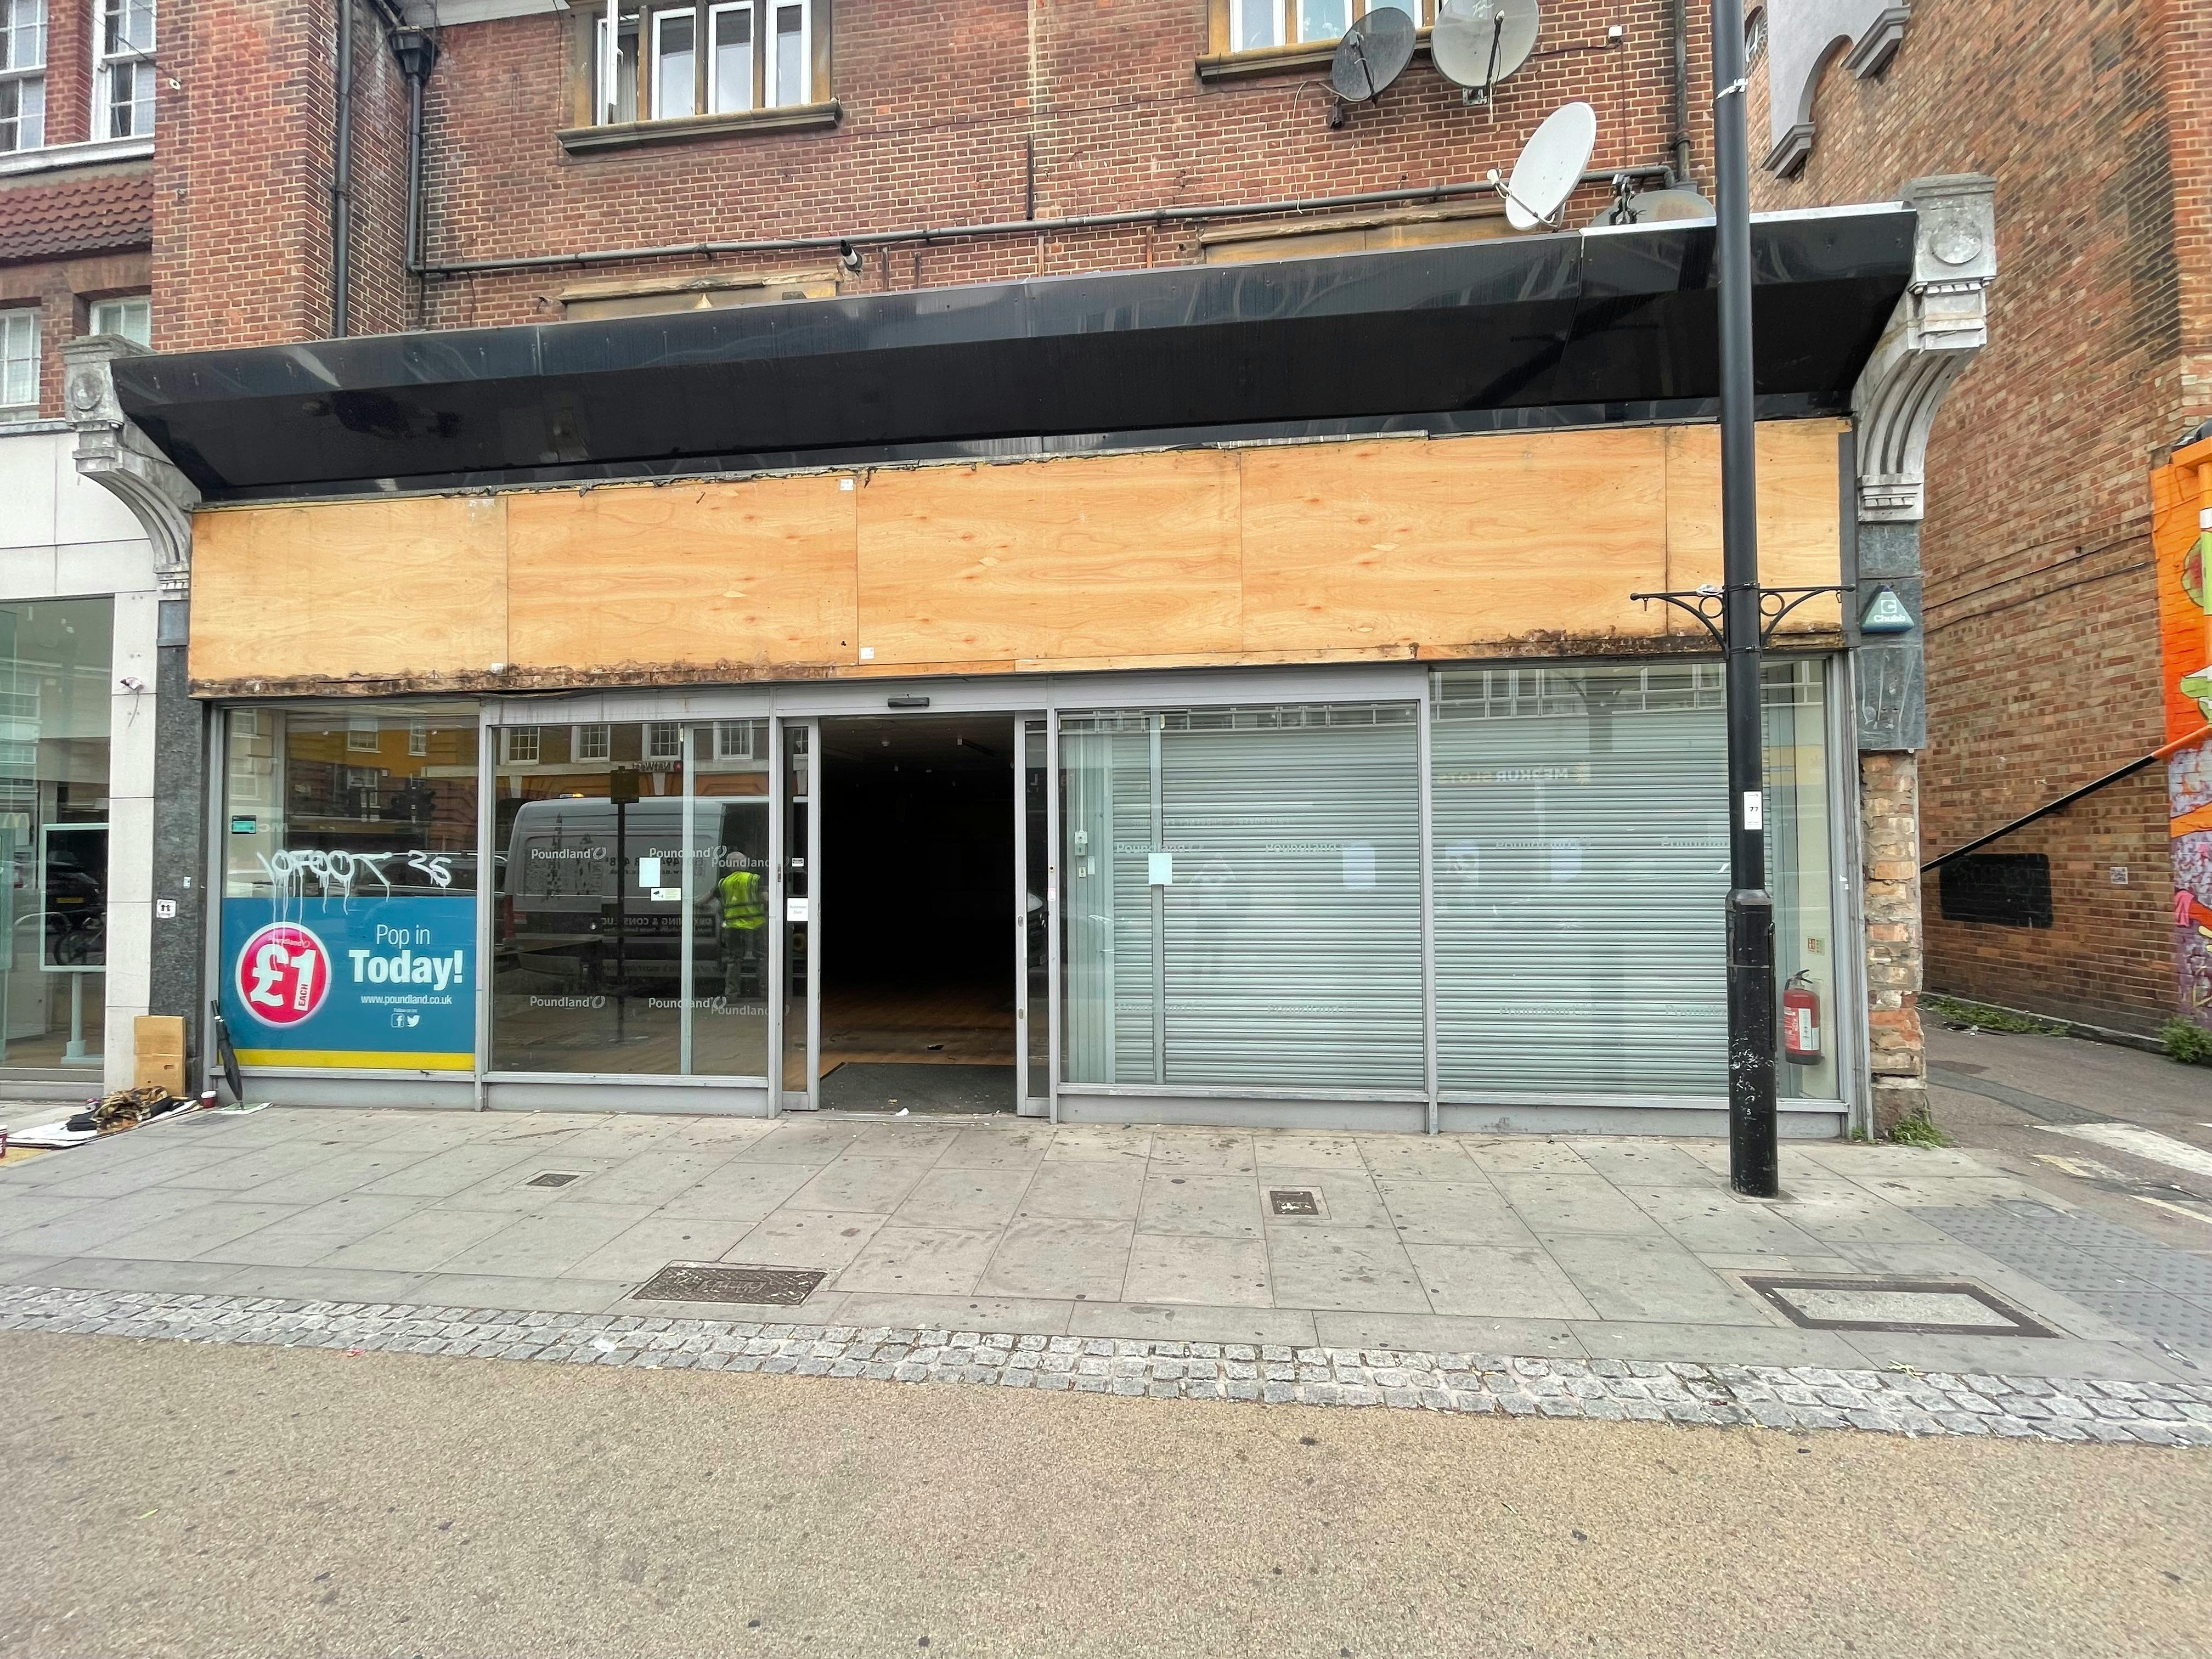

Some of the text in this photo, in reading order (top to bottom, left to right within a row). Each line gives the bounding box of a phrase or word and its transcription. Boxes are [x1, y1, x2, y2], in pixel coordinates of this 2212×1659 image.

[531, 848, 590, 860] Poundland
[376, 924, 431, 950] Pop in
[250, 943, 317, 1012] £1
[348, 949, 464, 991] Today!
[298, 984, 308, 1007] EACH
[360, 994, 453, 1006] www.poundland.co.uk
[530, 996, 590, 1007] Poundland
